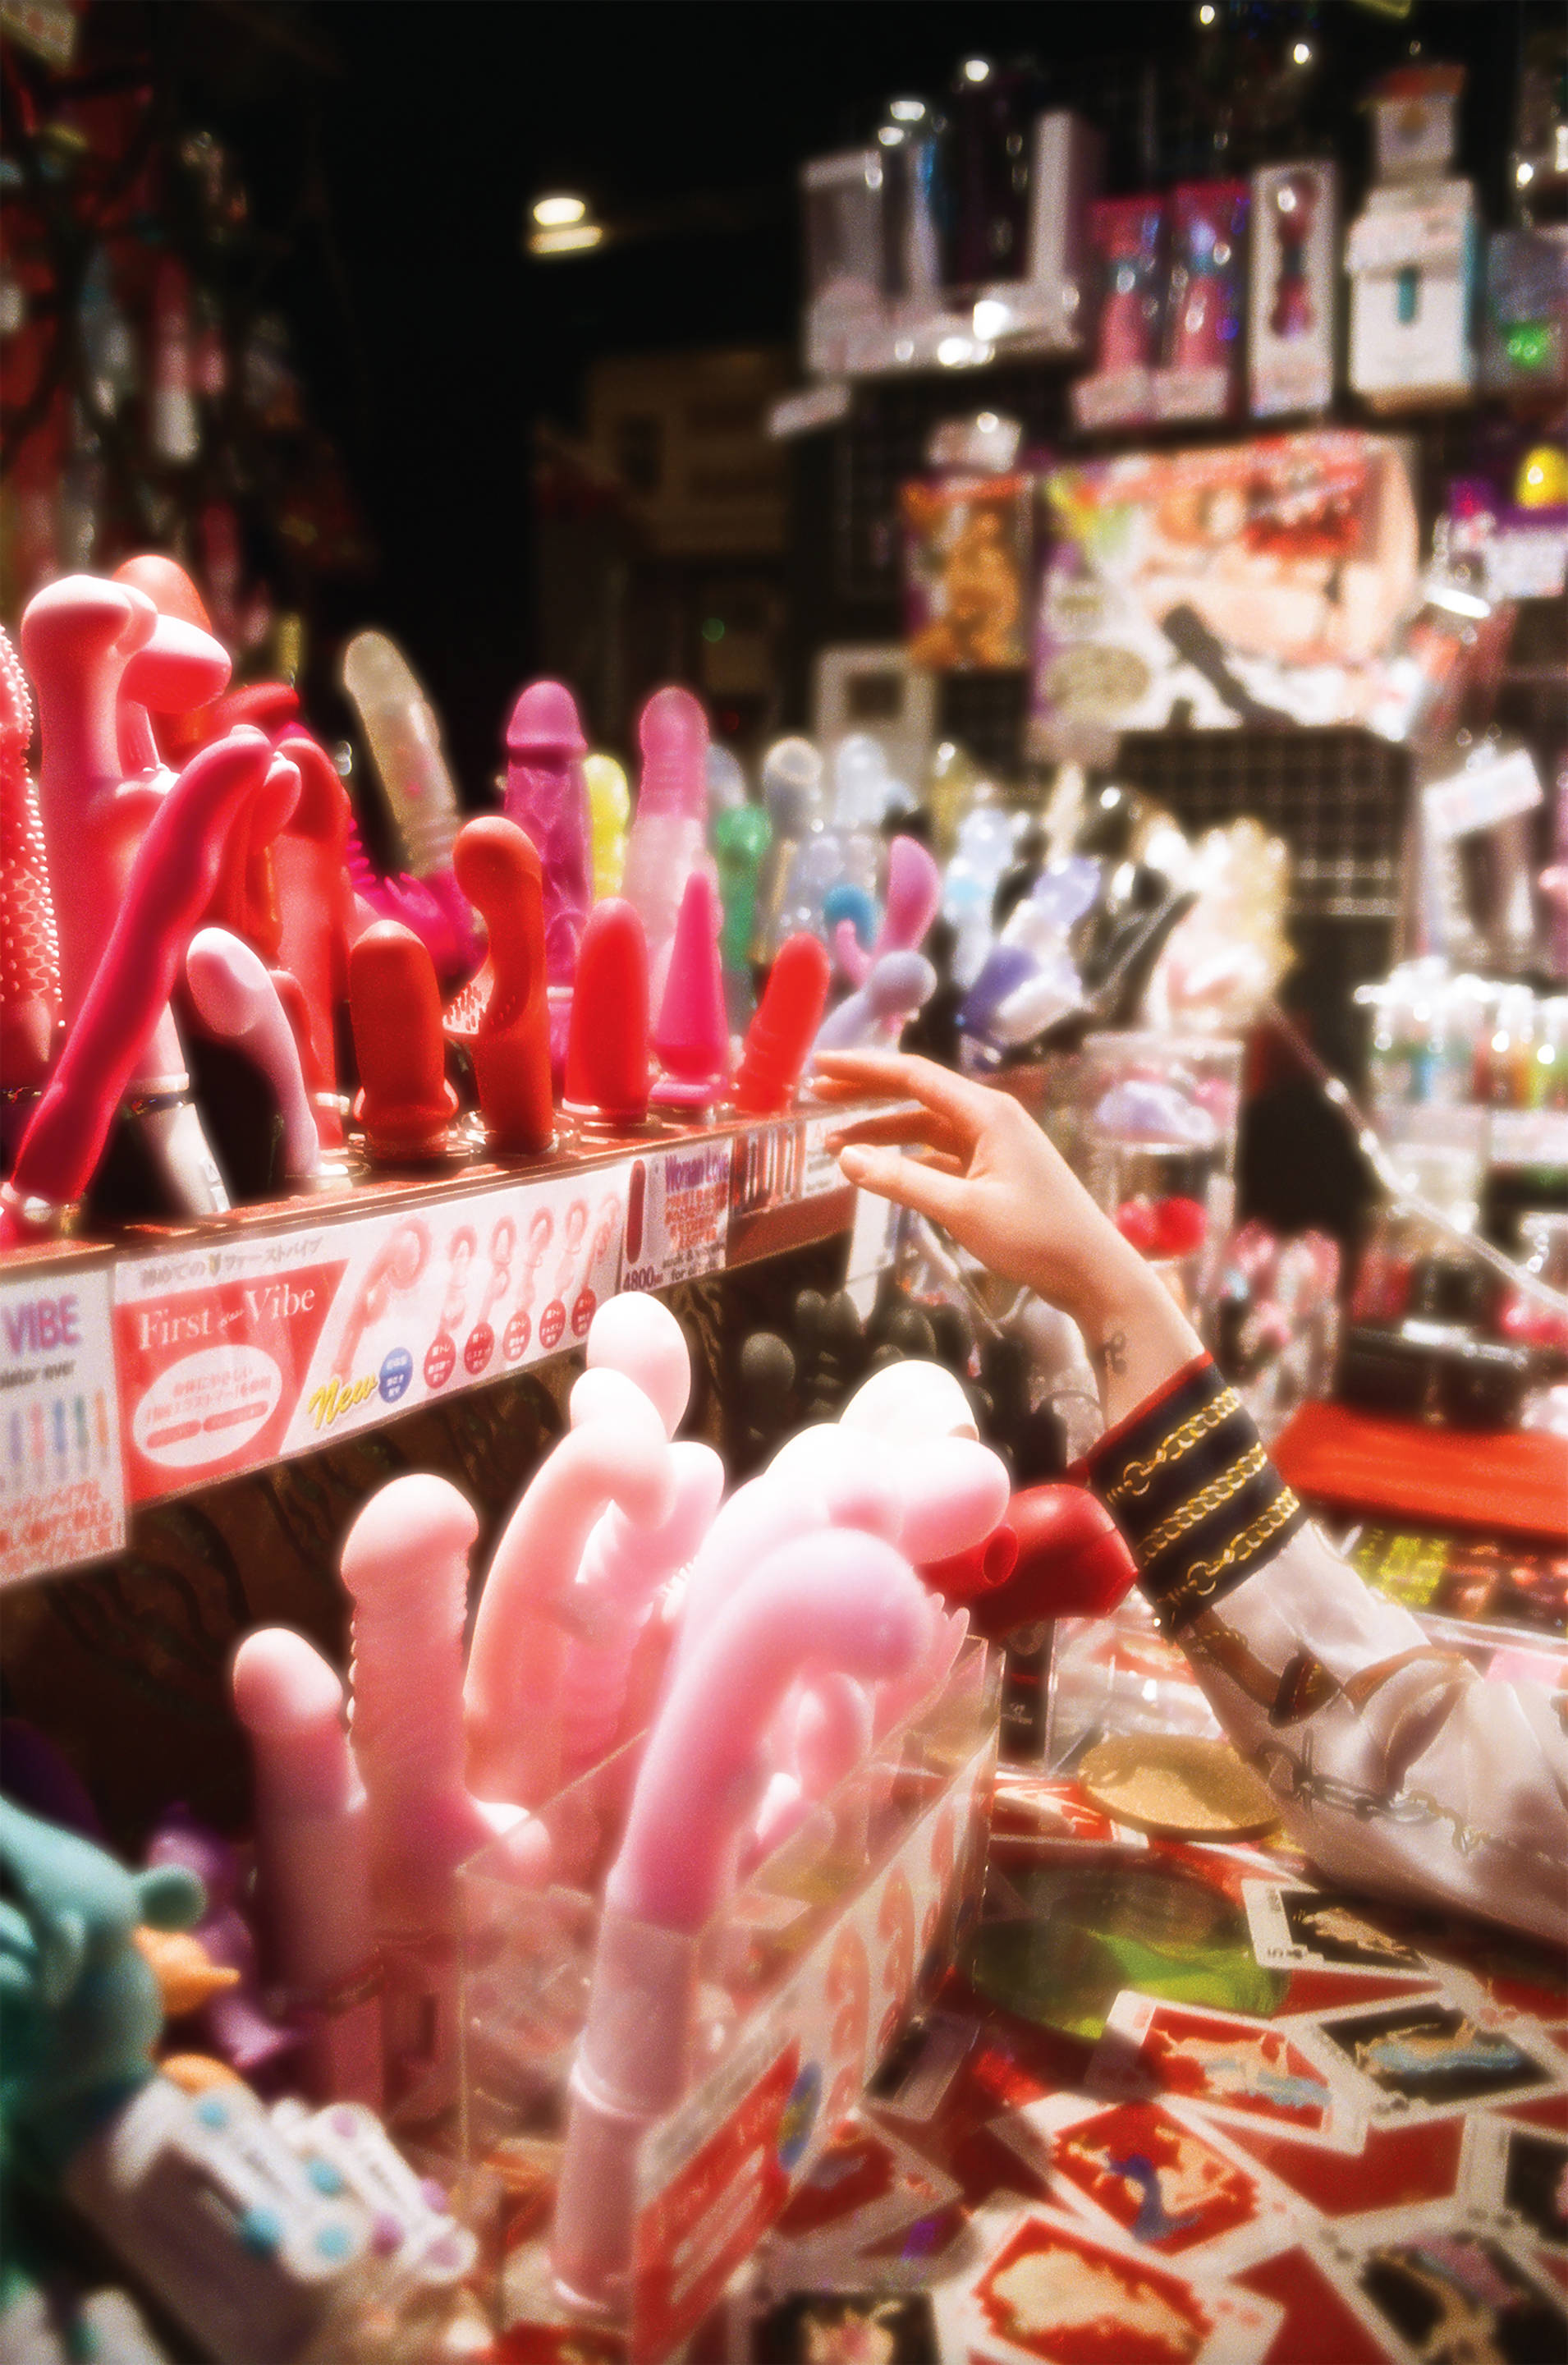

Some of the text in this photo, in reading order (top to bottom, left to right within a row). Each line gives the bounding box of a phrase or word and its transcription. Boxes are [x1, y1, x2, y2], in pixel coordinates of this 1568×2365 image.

[2, 1293, 81, 1355] VIBE
[139, 1307, 214, 1351] First
[245, 1284, 315, 1320] Vibe
[308, 1371, 379, 1430] New
